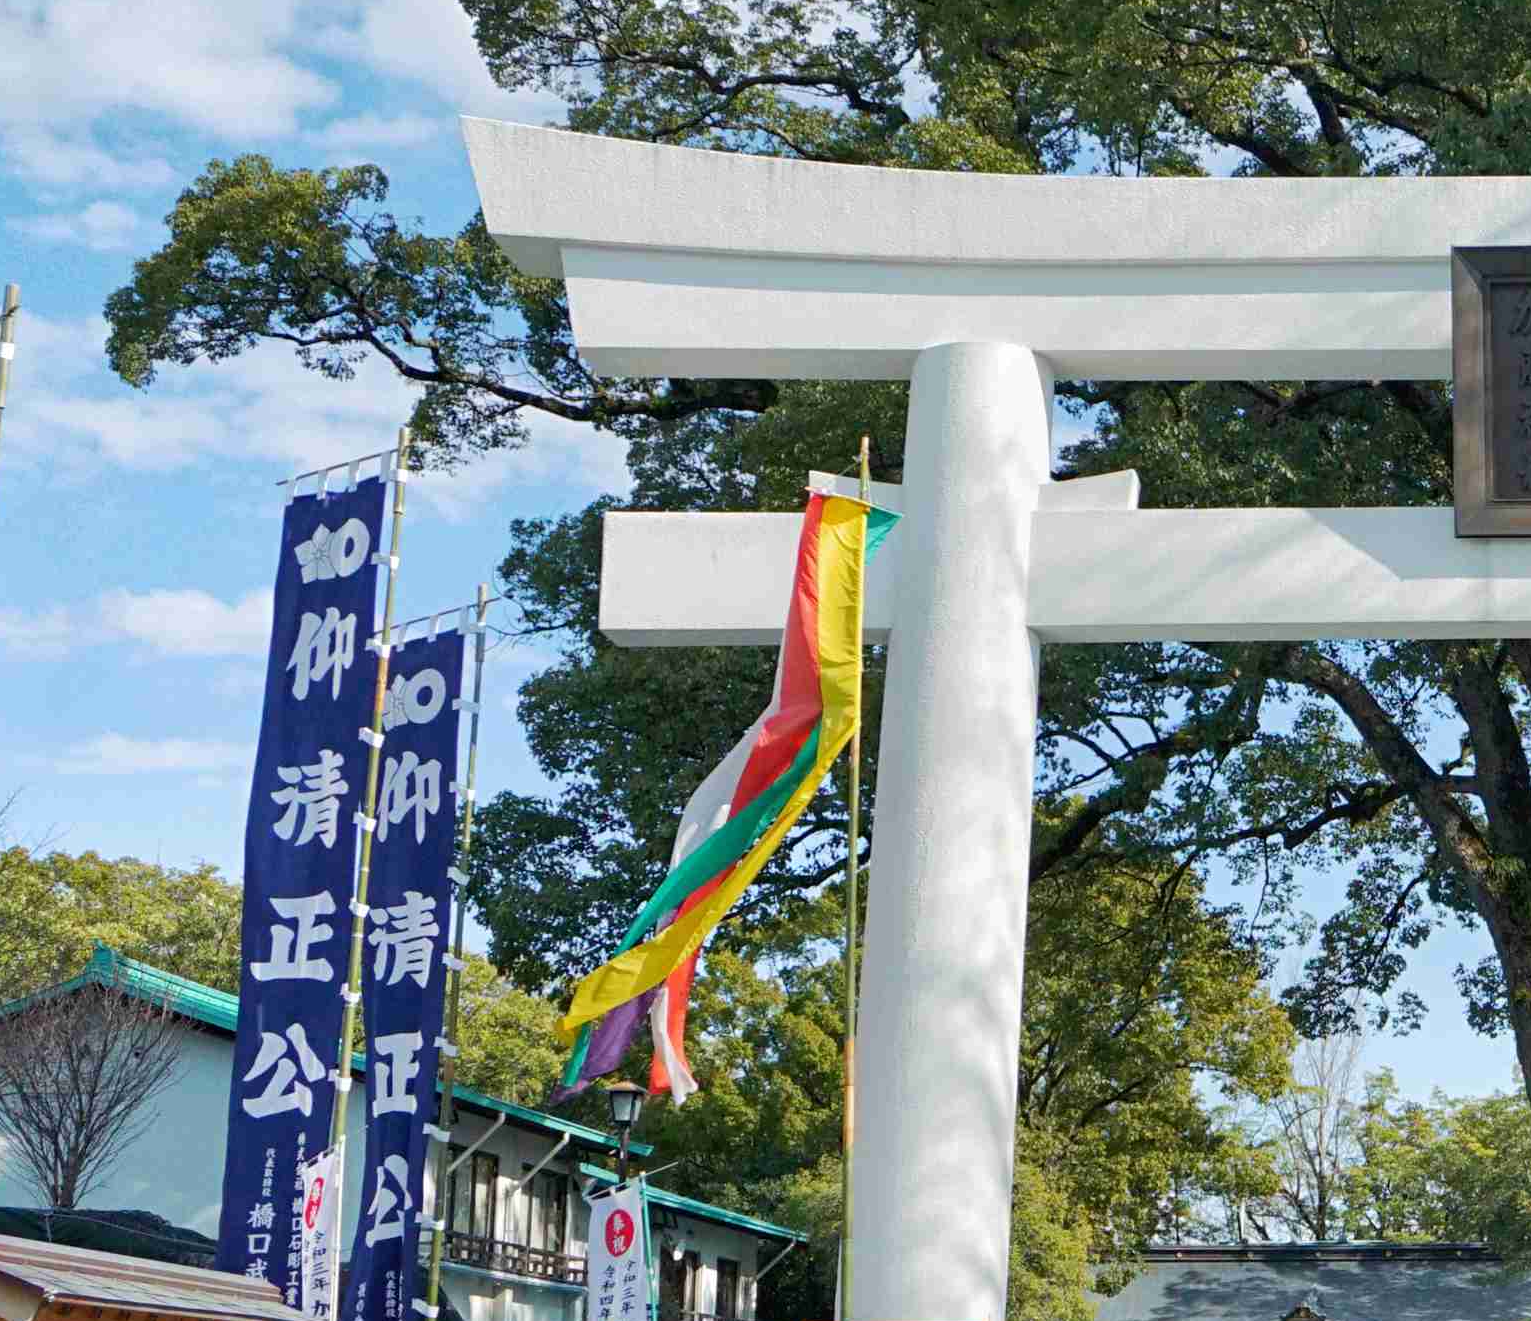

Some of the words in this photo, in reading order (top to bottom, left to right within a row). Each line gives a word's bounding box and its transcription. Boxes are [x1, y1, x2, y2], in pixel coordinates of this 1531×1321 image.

[241, 606, 358, 1119] 仰清正公
[367, 750, 444, 1251] 仰清正公
